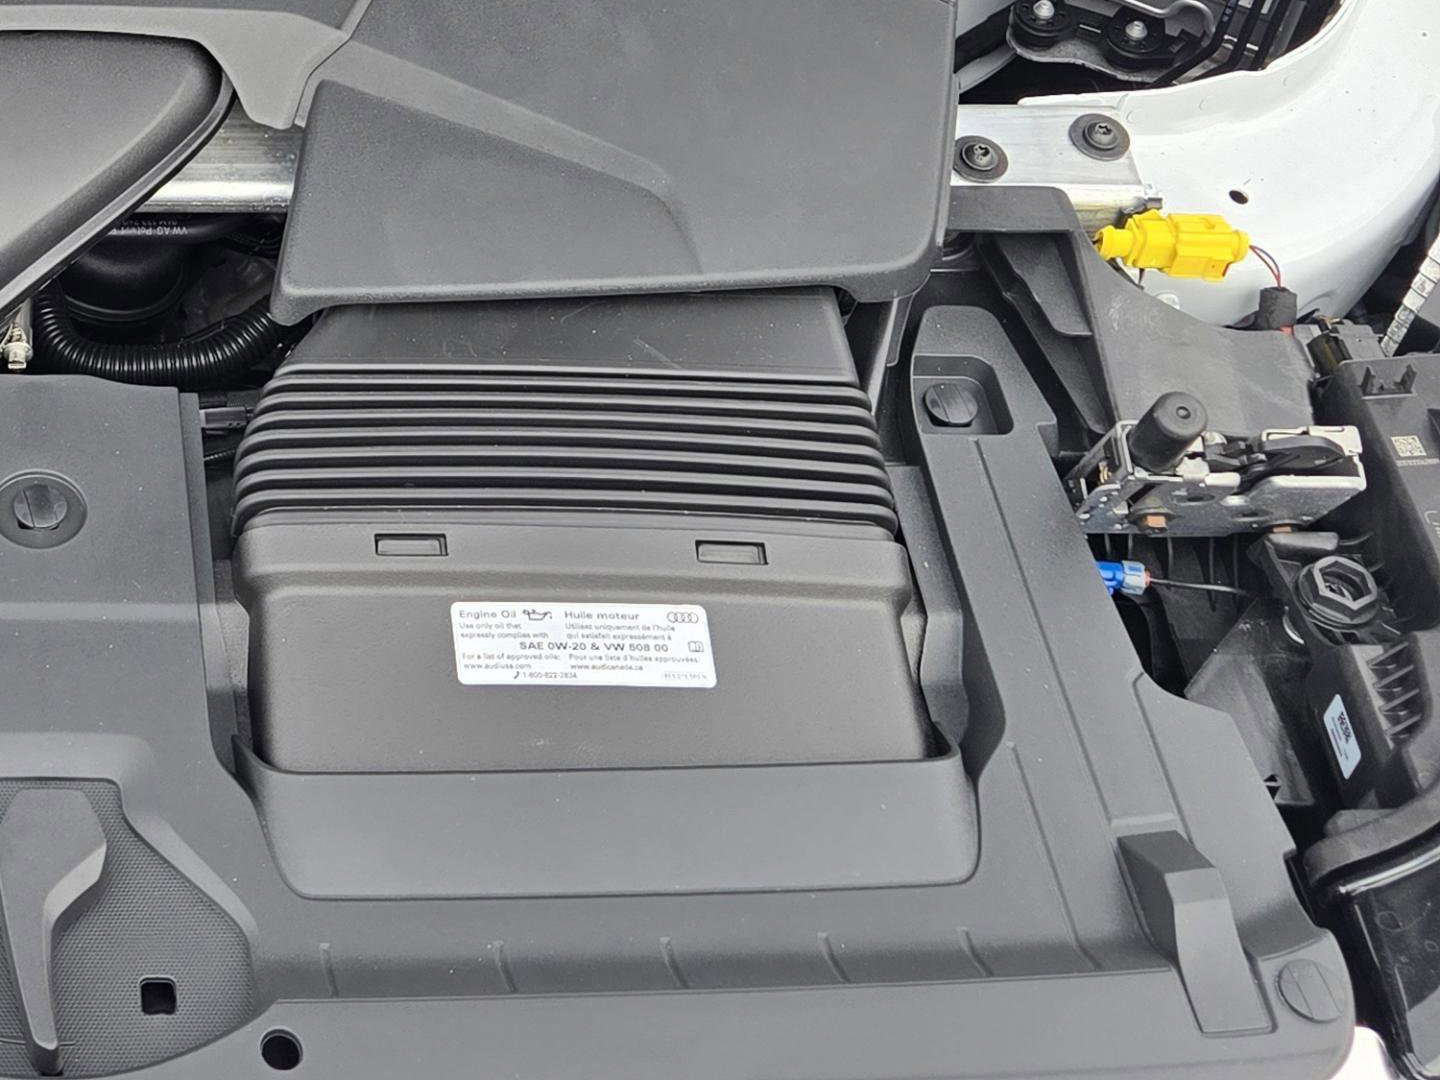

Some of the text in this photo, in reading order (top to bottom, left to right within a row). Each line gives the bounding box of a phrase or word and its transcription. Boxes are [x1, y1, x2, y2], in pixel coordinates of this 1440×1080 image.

[459, 609, 517, 620] Engine Oil
[564, 610, 640, 620] Huile moteur
[519, 641, 669, 652] SAE 0W-20 & VW 508 00
